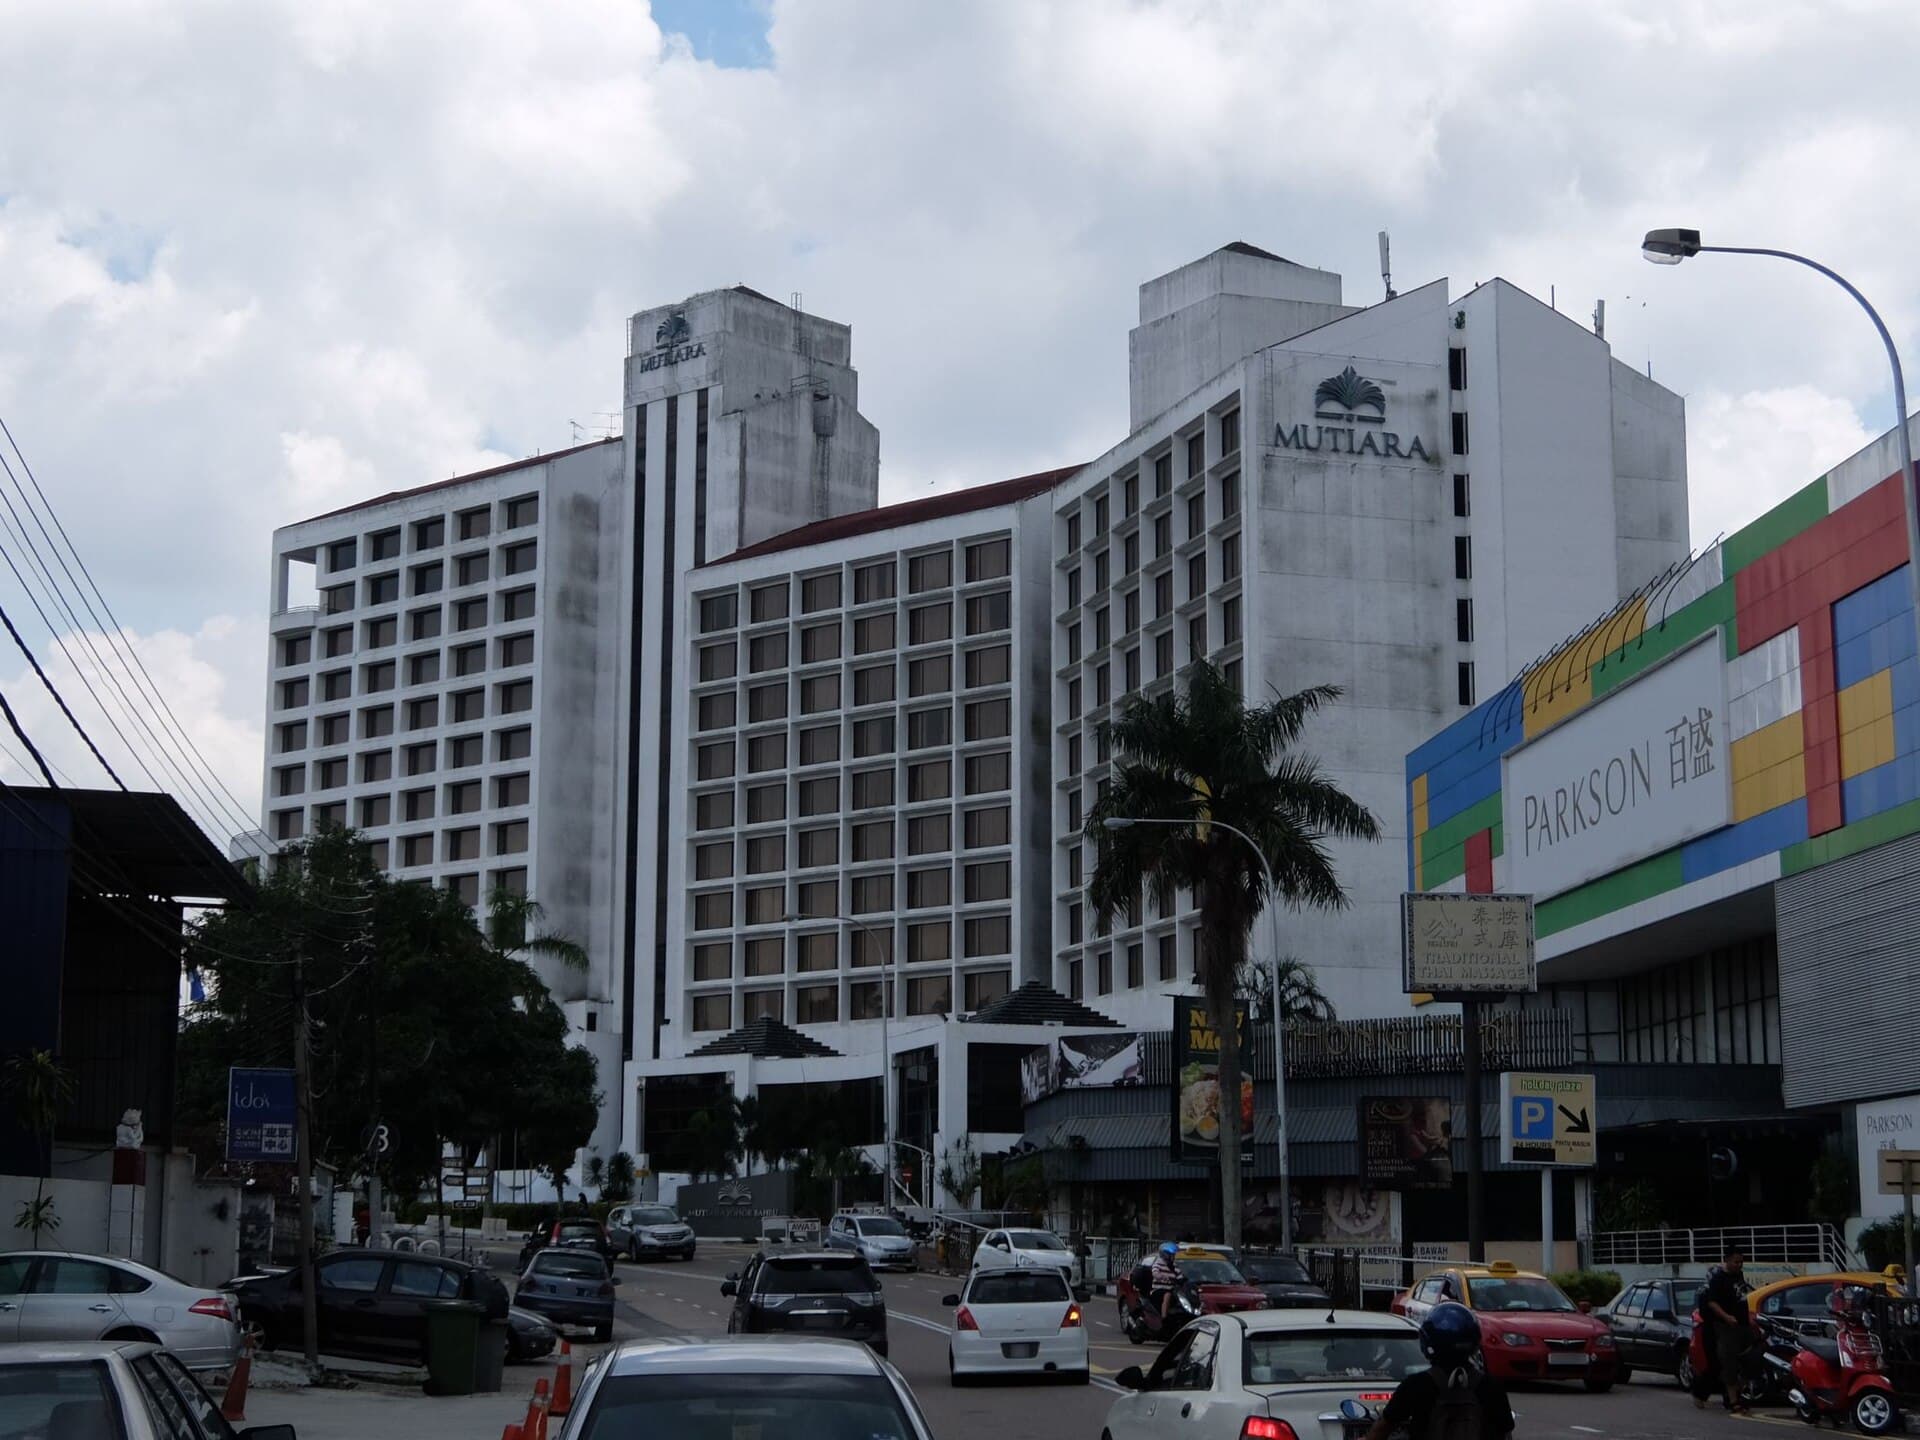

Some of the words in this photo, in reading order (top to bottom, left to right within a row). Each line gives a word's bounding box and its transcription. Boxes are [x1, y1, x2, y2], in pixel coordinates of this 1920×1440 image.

[640, 343, 706, 374] MUTIARA
[1274, 422, 1431, 462] MUTIARA
[1525, 740, 1651, 857] PARKSON
[1665, 707, 1715, 789] 百盛
[1425, 952, 1520, 965] TRADITIONAL
[1420, 967, 1453, 978] THAI
[1461, 967, 1525, 979] MASSAGE
[1557, 1080, 1583, 1093] plaza
[1521, 1102, 1545, 1134] P
[1867, 1112, 1912, 1136] PARKSON
[1368, 1247, 1397, 1256] KERETA
[1420, 1247, 1448, 1256] BAWAH
